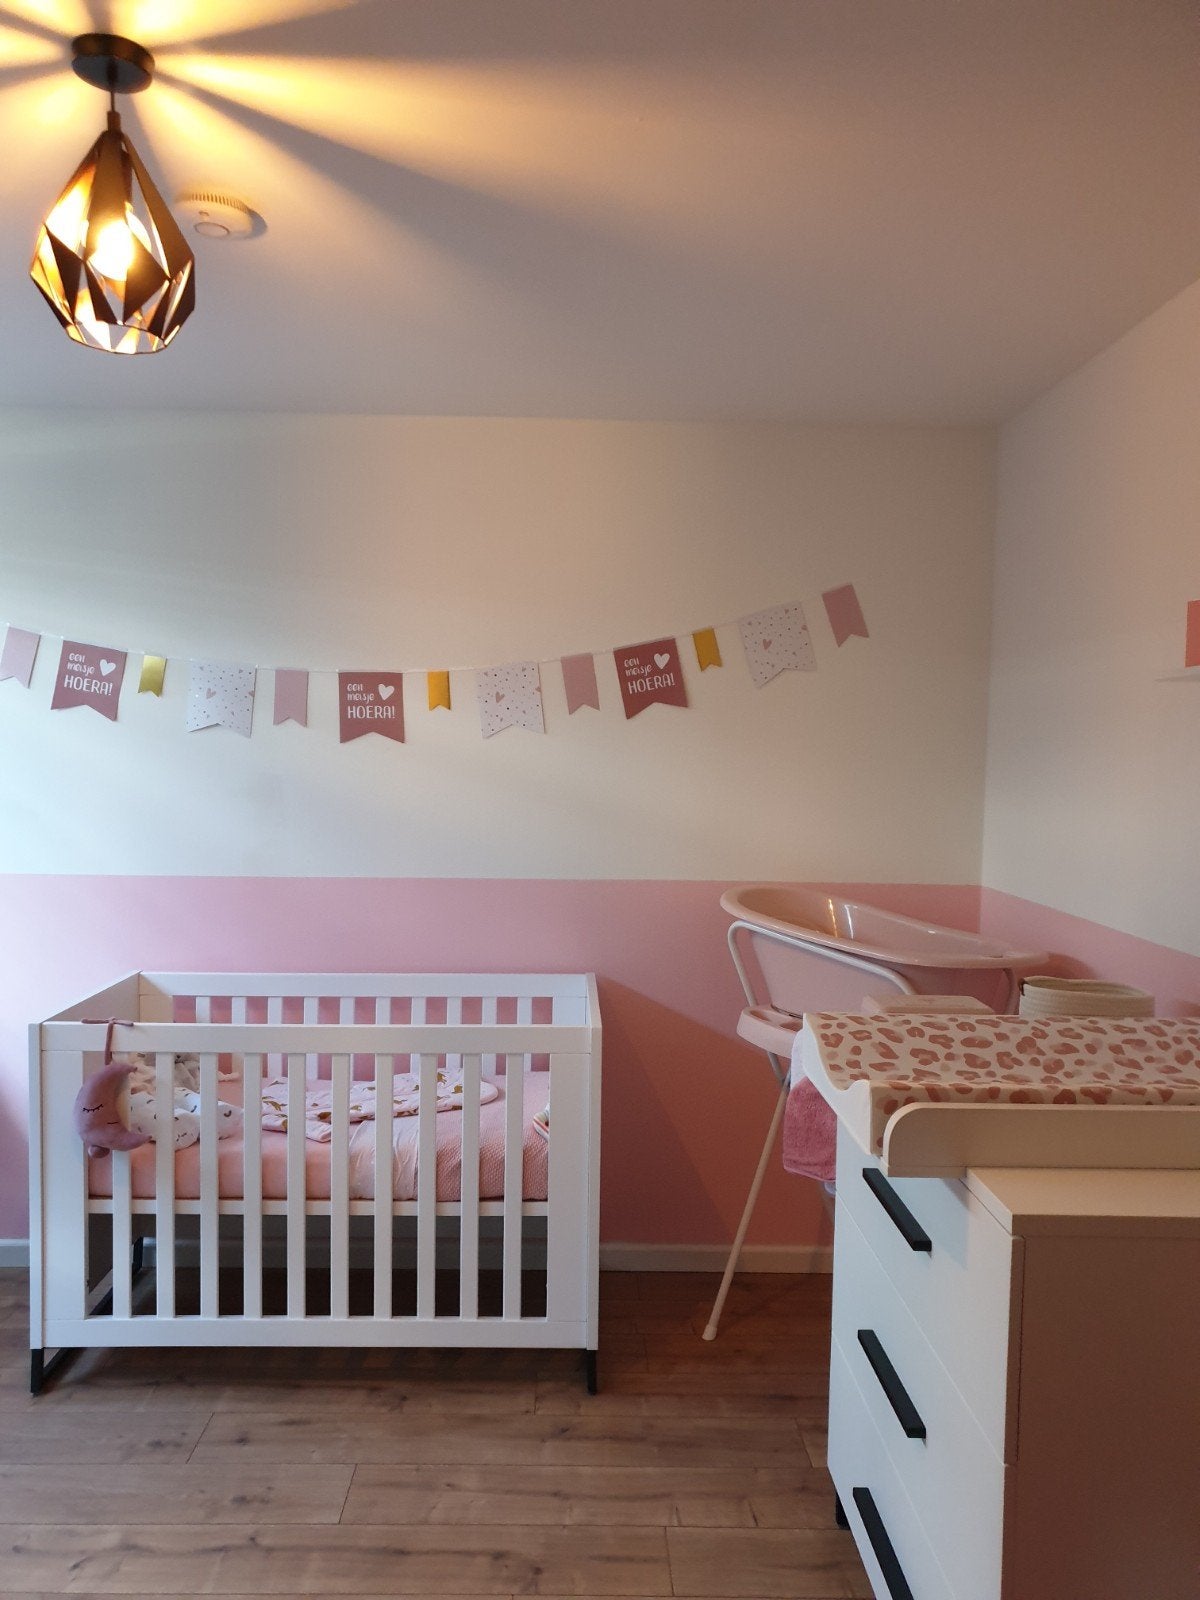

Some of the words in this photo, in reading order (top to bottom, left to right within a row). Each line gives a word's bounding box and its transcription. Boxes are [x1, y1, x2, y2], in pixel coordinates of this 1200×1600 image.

[63, 674, 113, 696] HOERA!
[627, 672, 676, 695] HOERA!
[347, 705, 396, 719] HOERA!
